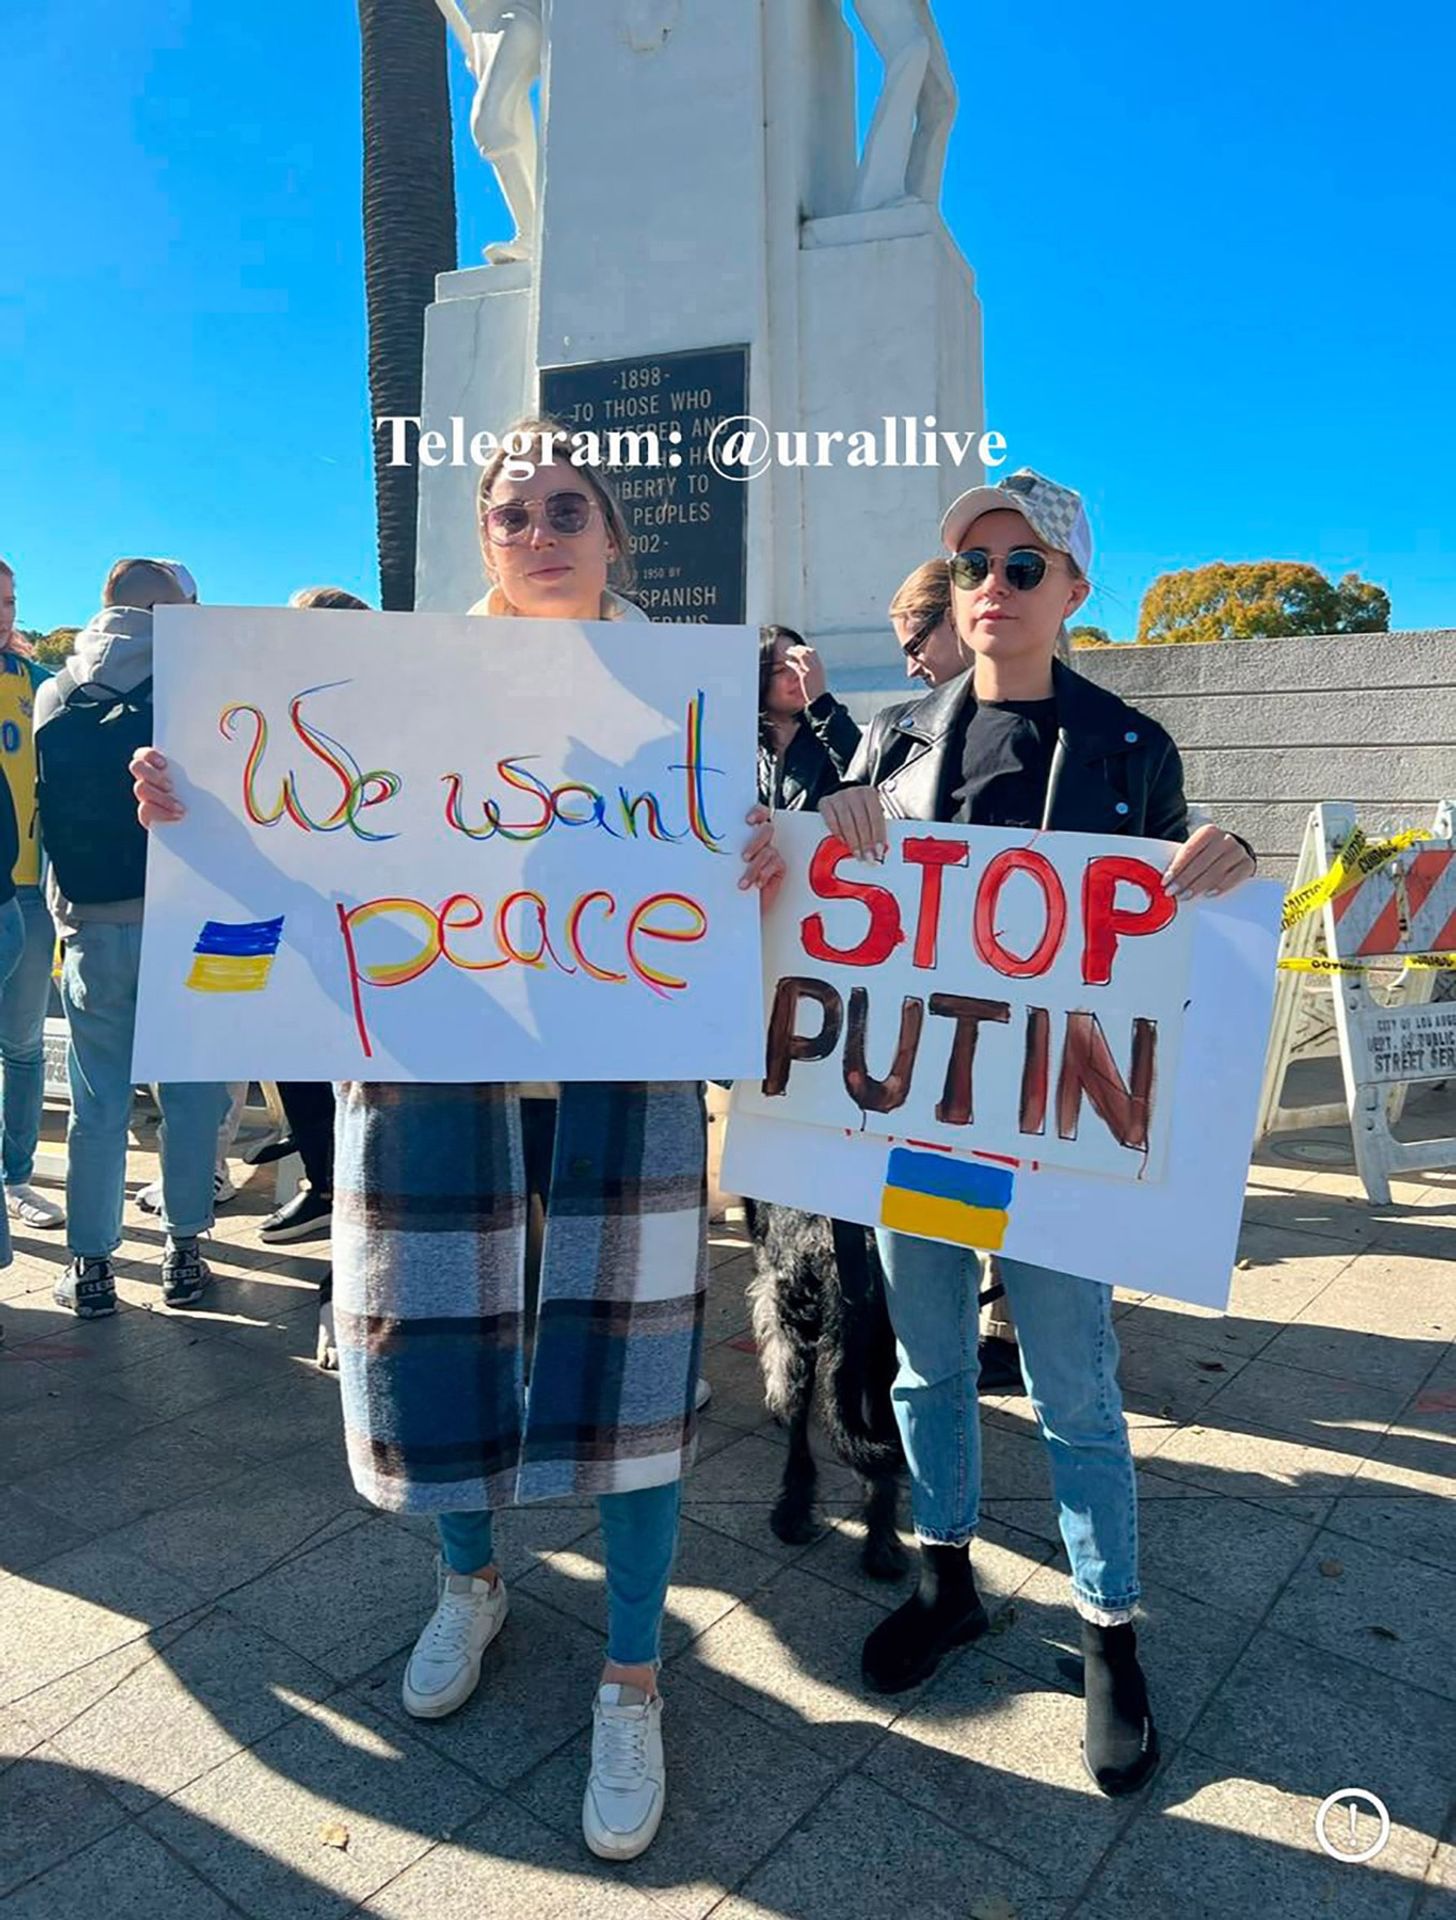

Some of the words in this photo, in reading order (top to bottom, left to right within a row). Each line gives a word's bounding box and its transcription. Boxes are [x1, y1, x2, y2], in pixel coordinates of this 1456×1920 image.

[574, 403, 593, 422] TO
[605, 394, 660, 419] THOSE
[670, 389, 711, 412] WHO
[615, 476, 677, 500] IBERTY
[688, 474, 709, 494] TO
[634, 502, 710, 526] PEOPLES
[640, 586, 717, 609] SPANISH
[219, 678, 401, 842] We
[440, 688, 732, 855] want
[800, 834, 1178, 986] STOP
[336, 890, 709, 1058] peace
[761, 976, 1158, 1153] PUTIN
[1375, 1050, 1424, 1074] STREET
